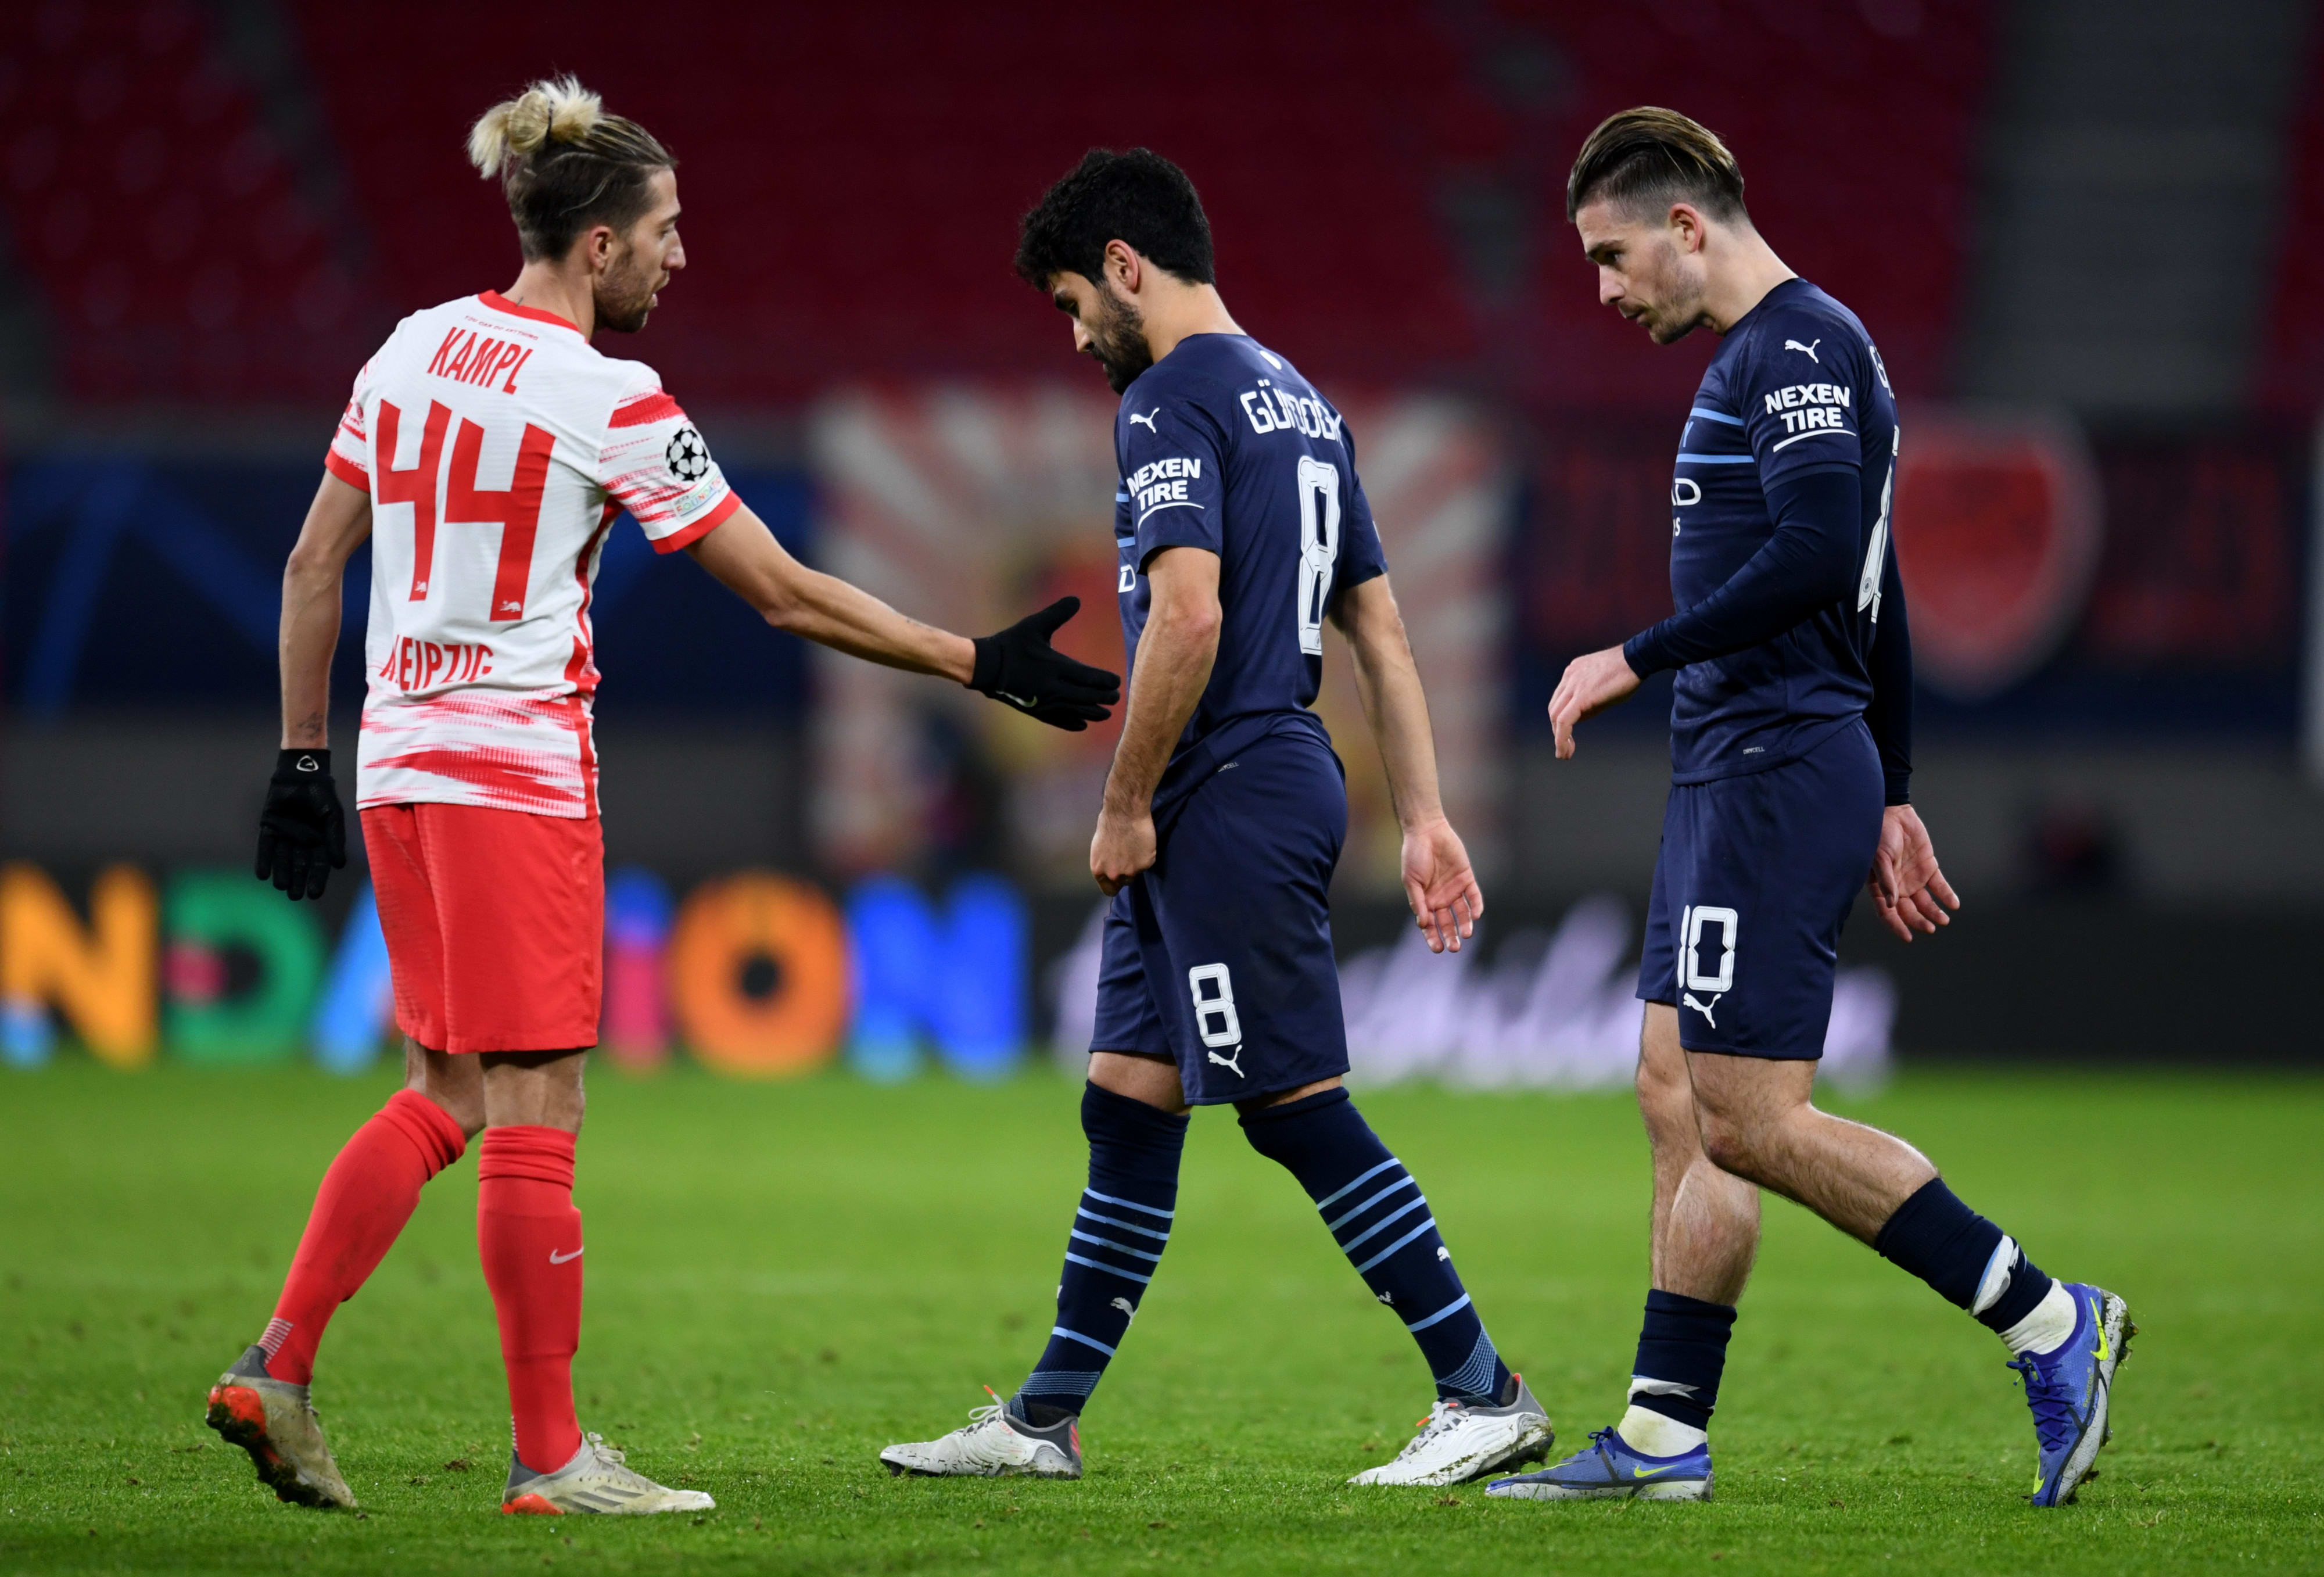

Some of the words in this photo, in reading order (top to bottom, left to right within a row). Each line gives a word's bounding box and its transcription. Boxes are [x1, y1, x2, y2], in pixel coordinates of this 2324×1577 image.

[427, 327, 533, 395] KAMPL
[1764, 384, 1850, 414] NEXEN
[1780, 407, 1844, 433] TIRE
[376, 399, 555, 621] 44
[1126, 458, 1201, 498] NEXEN
[1137, 479, 1189, 512] TIRE
[1297, 455, 1340, 658] 8
[1678, 905, 1738, 992] 10
[1189, 962, 1242, 1048] 8
